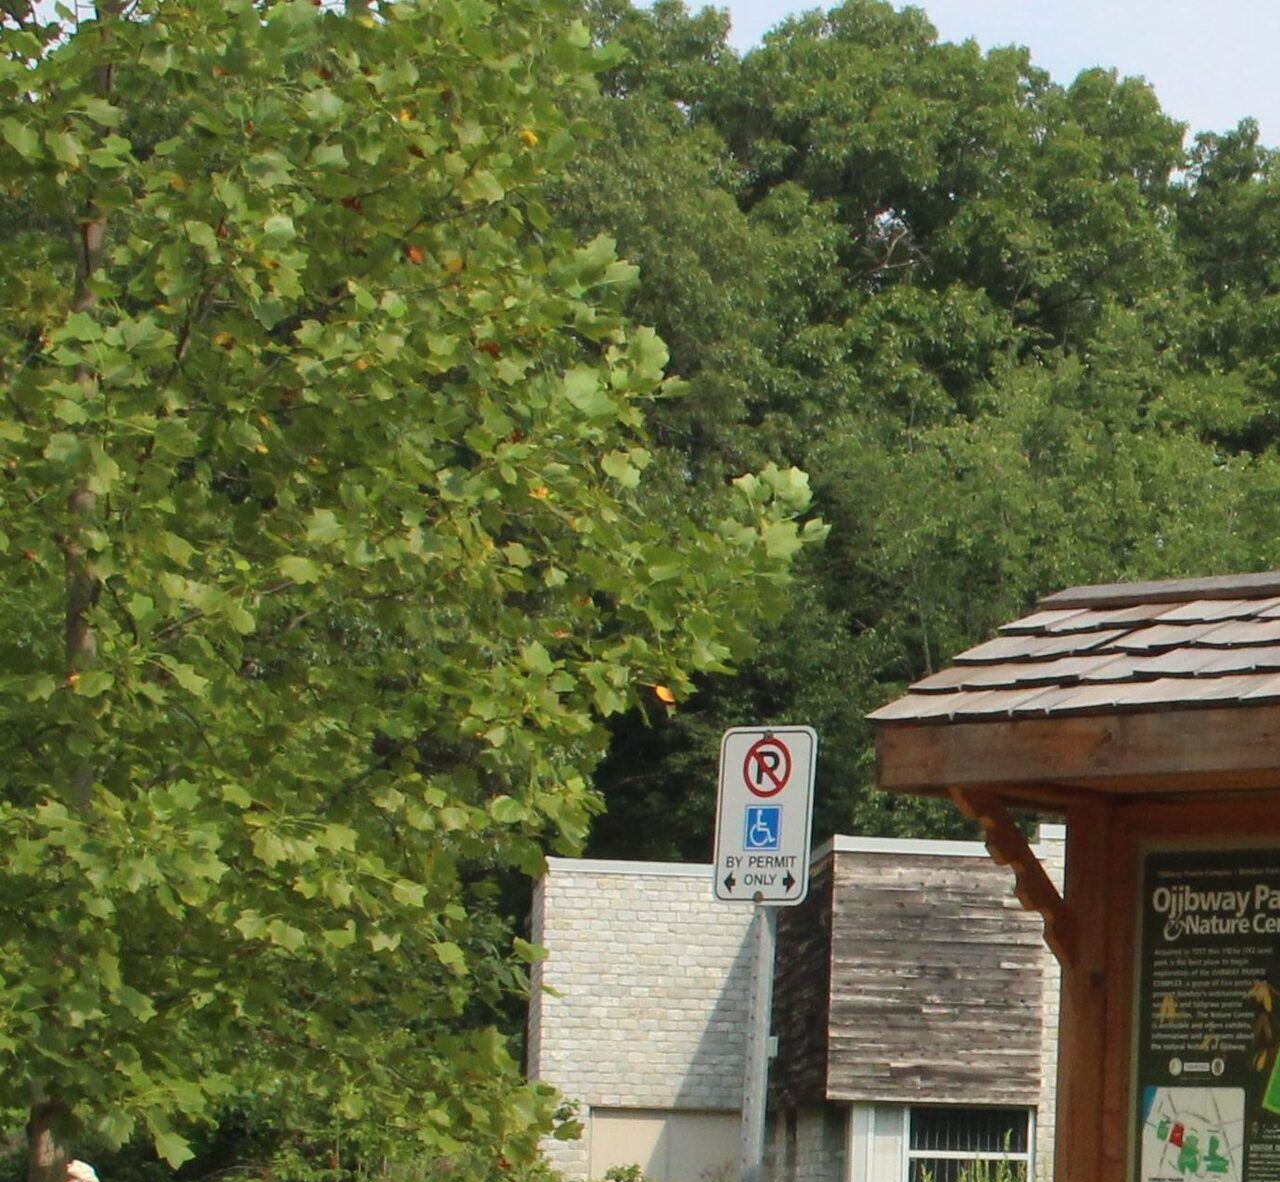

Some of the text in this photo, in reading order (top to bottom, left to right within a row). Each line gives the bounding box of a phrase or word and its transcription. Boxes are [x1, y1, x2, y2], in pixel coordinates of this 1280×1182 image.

[725, 855, 797, 869] BY PERMIT
[744, 873, 778, 886] ONLY
[1152, 885, 1250, 919] Ojibway
[1185, 914, 1250, 935] Nature
